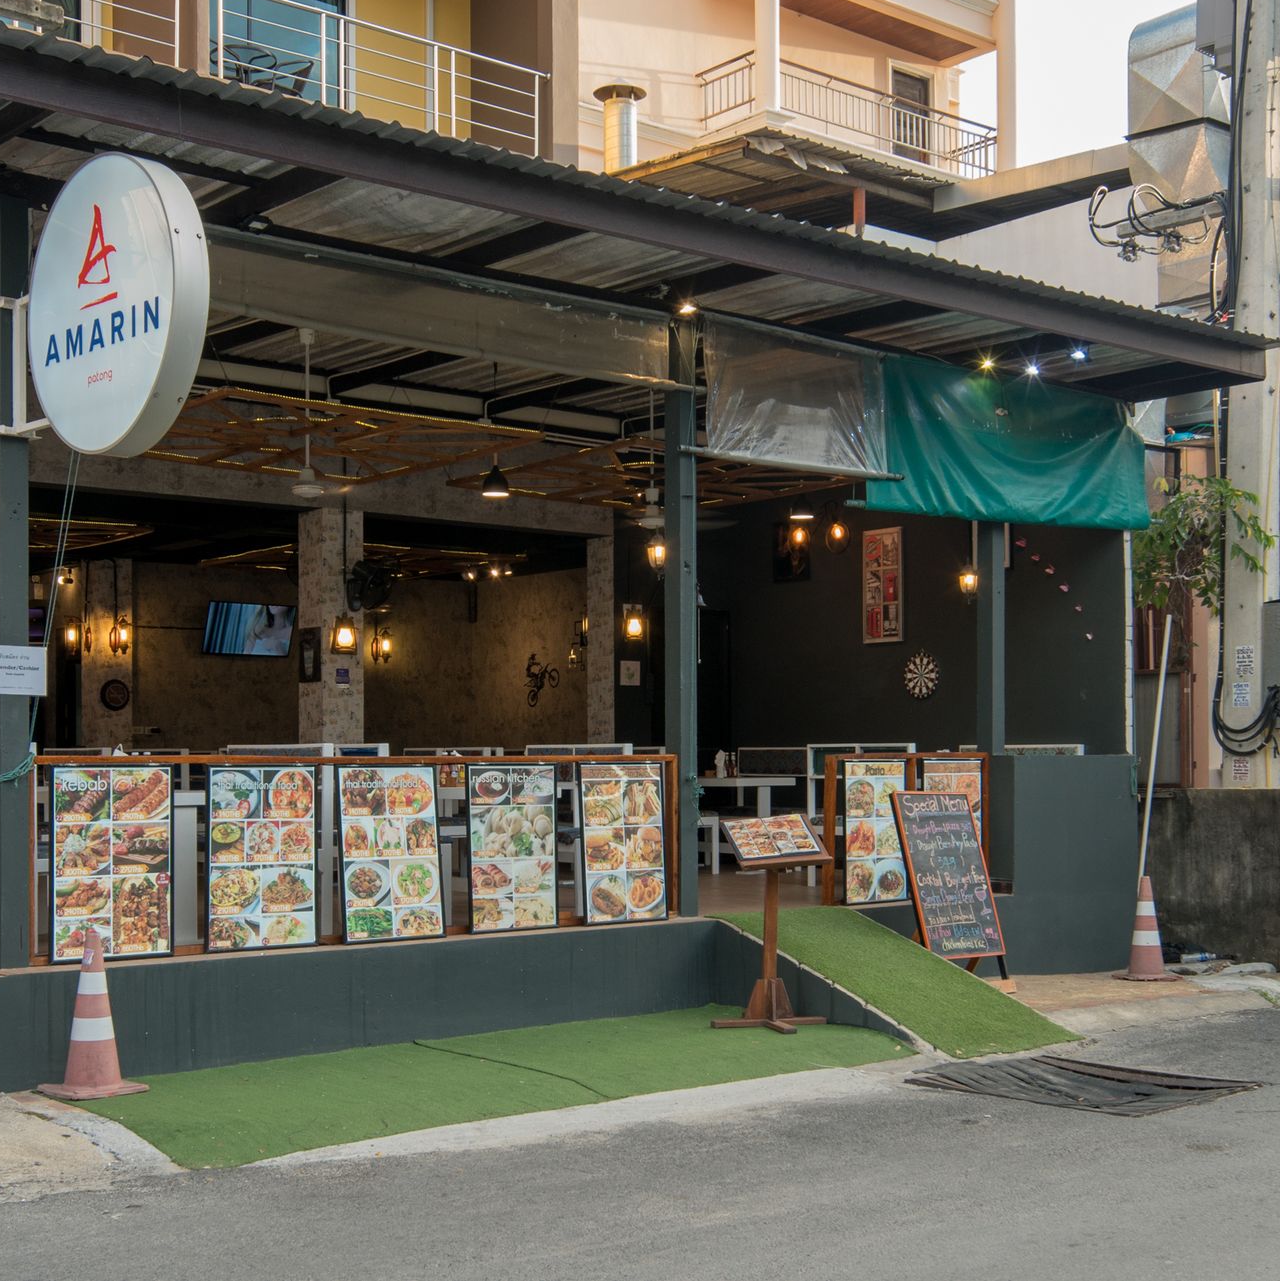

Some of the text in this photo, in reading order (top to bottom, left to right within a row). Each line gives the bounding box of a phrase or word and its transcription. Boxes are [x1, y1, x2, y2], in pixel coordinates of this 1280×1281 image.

[45, 295, 160, 367] AMARIN
[87, 369, 114, 387] patong
[60, 775, 108, 792] kebab
[472, 772, 540, 783] russian kitchen
[941, 795, 969, 812] Menu
